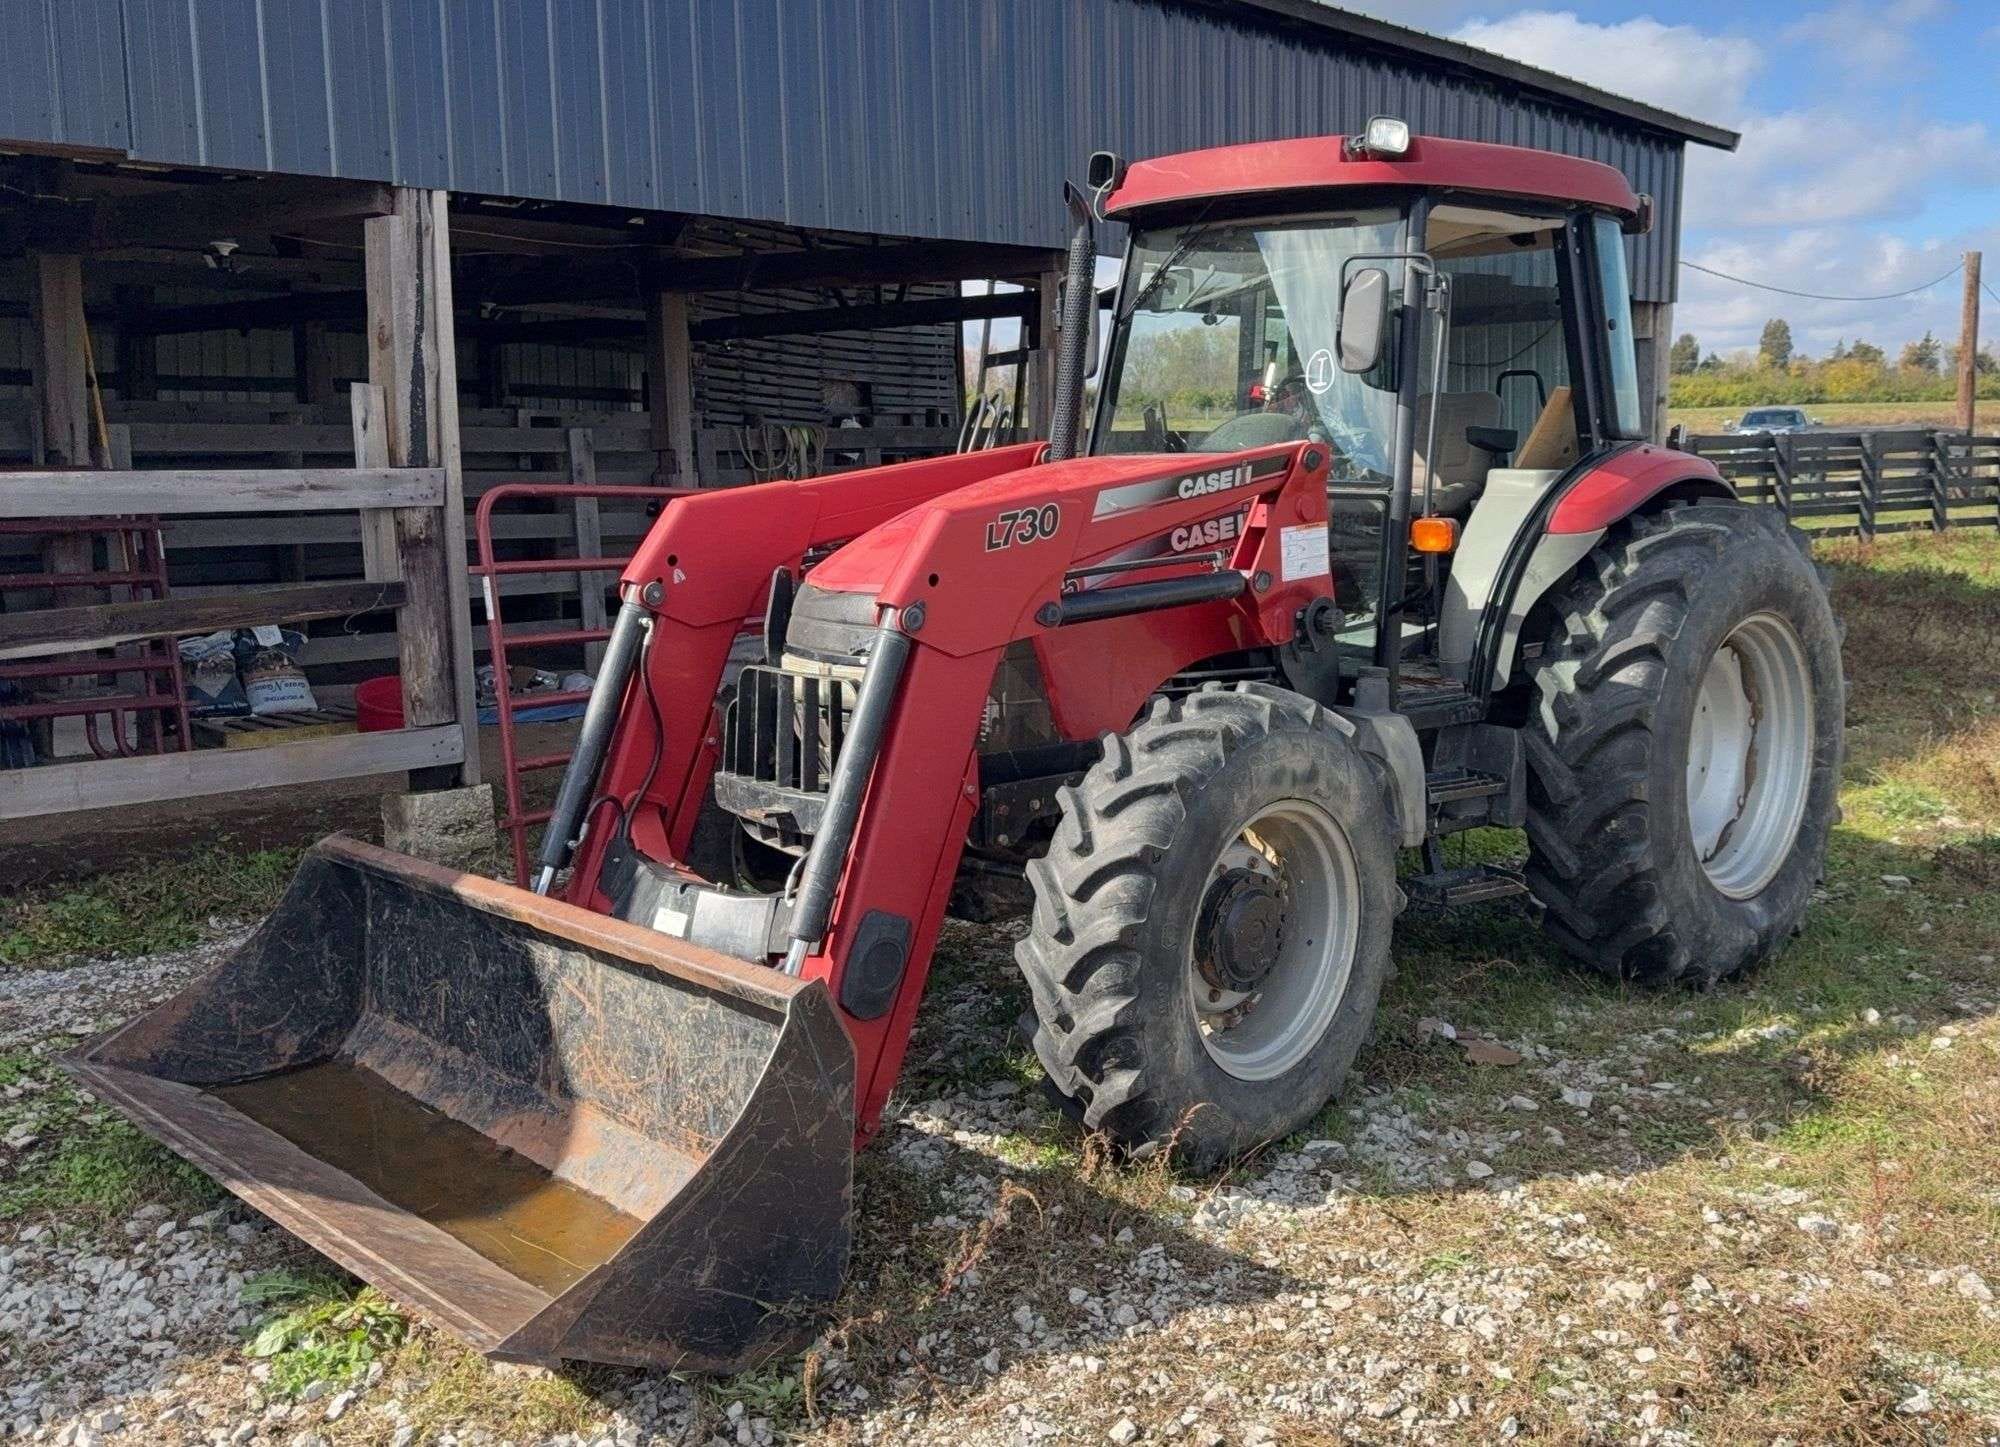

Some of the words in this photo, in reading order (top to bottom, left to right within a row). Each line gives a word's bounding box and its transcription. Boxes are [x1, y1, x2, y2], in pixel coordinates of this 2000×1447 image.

[1178, 469, 1234, 499] CASE
[985, 502, 1060, 552] L730
[1170, 515, 1235, 552] CASE
